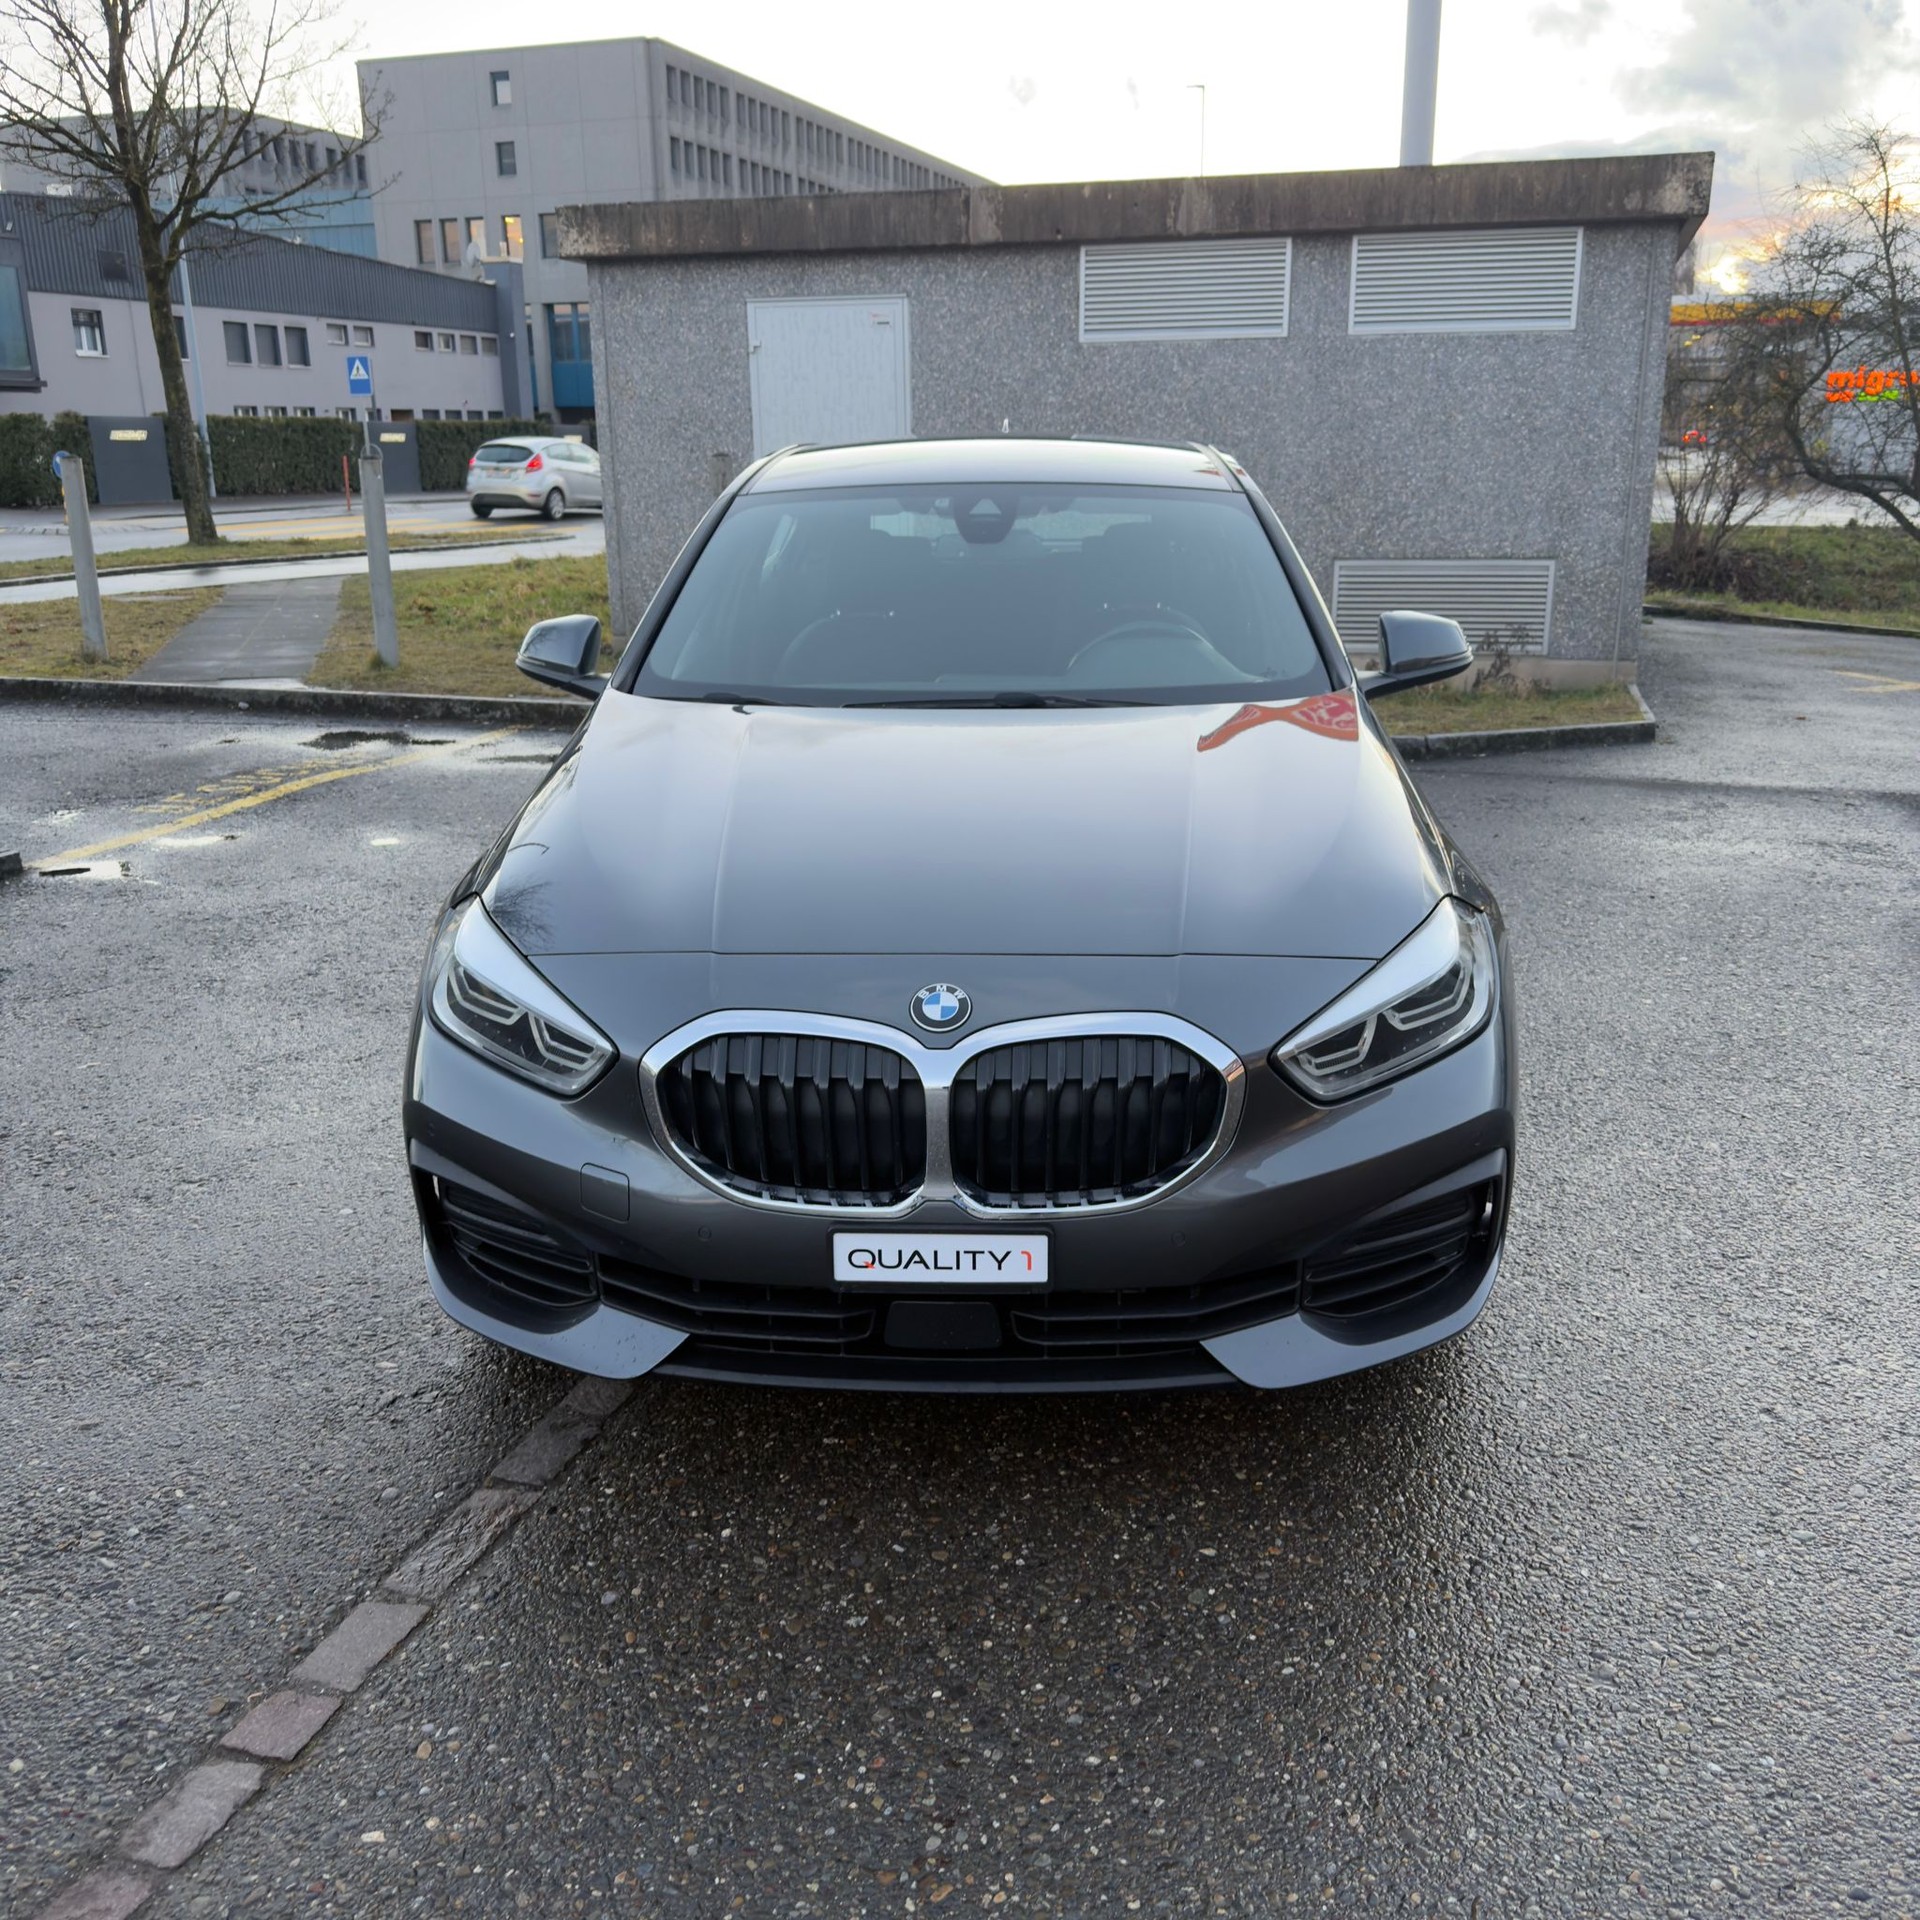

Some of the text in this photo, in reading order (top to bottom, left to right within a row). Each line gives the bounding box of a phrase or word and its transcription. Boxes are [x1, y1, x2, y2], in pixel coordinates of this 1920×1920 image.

[918, 984, 966, 999] BMW
[848, 1248, 1032, 1270] QUALITY 1
